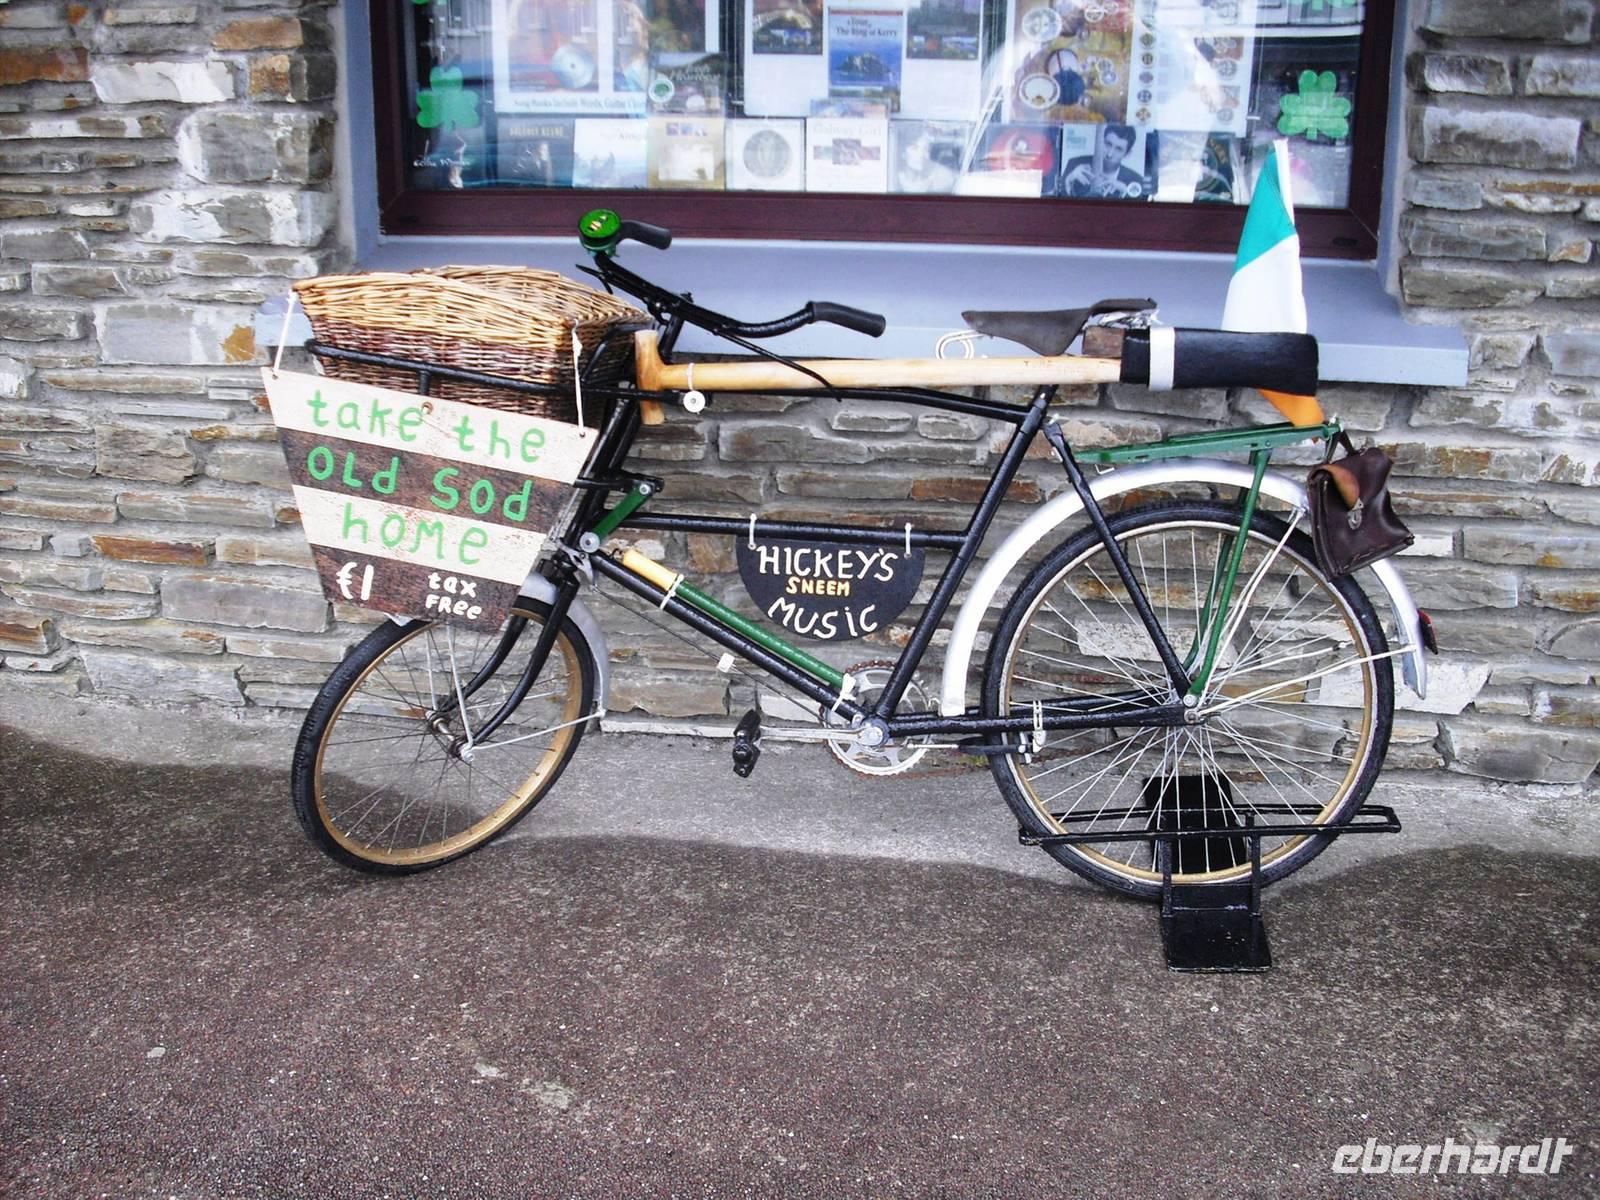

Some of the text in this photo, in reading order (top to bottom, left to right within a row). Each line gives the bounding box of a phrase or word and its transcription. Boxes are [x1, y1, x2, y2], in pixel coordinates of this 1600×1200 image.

[836, 27, 850, 36] The
[851, 28, 868, 38] Ring
[878, 29, 897, 39] Kerry
[307, 389, 545, 463] take the
[756, 545, 898, 581] HICKEY'S
[336, 561, 375, 601] €1
[428, 572, 478, 598] tax
[785, 576, 850, 597] SNEEM
